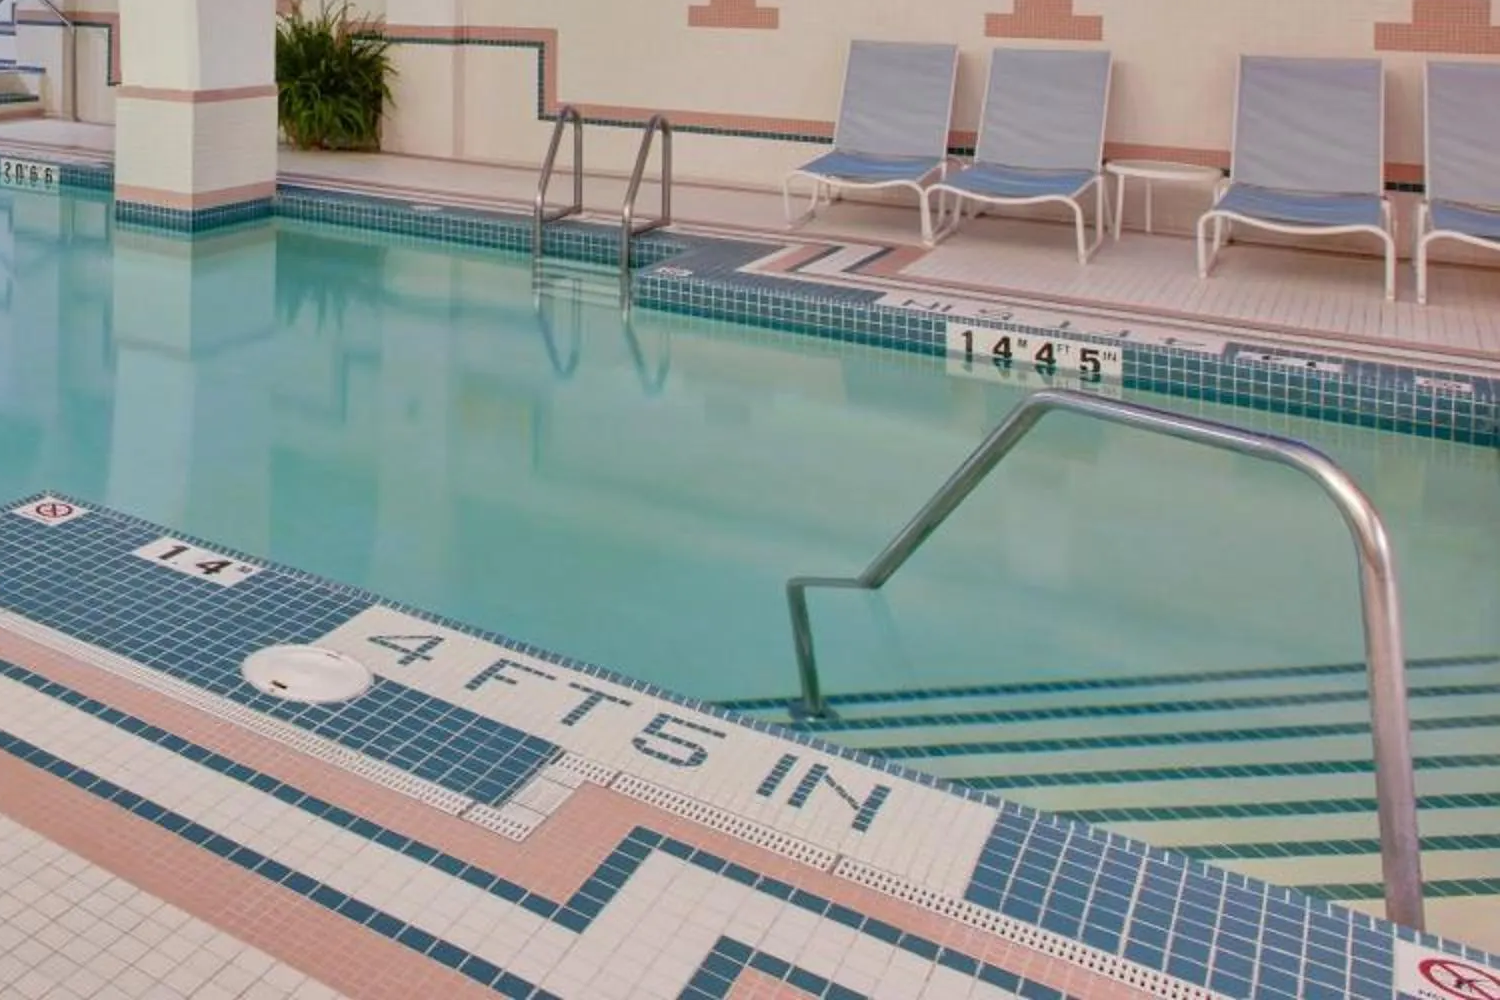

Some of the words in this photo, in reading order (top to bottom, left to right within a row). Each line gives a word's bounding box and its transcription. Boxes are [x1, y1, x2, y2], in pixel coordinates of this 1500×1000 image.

[1035, 342, 1057, 366] 4
[1057, 344, 1071, 354] FT
[1080, 348, 1100, 373] 5
[1103, 351, 1117, 363] IN
[366, 635, 445, 666] 4
[464, 658, 633, 727] FT
[631, 712, 727, 768] 5
[756, 753, 893, 834] IN
